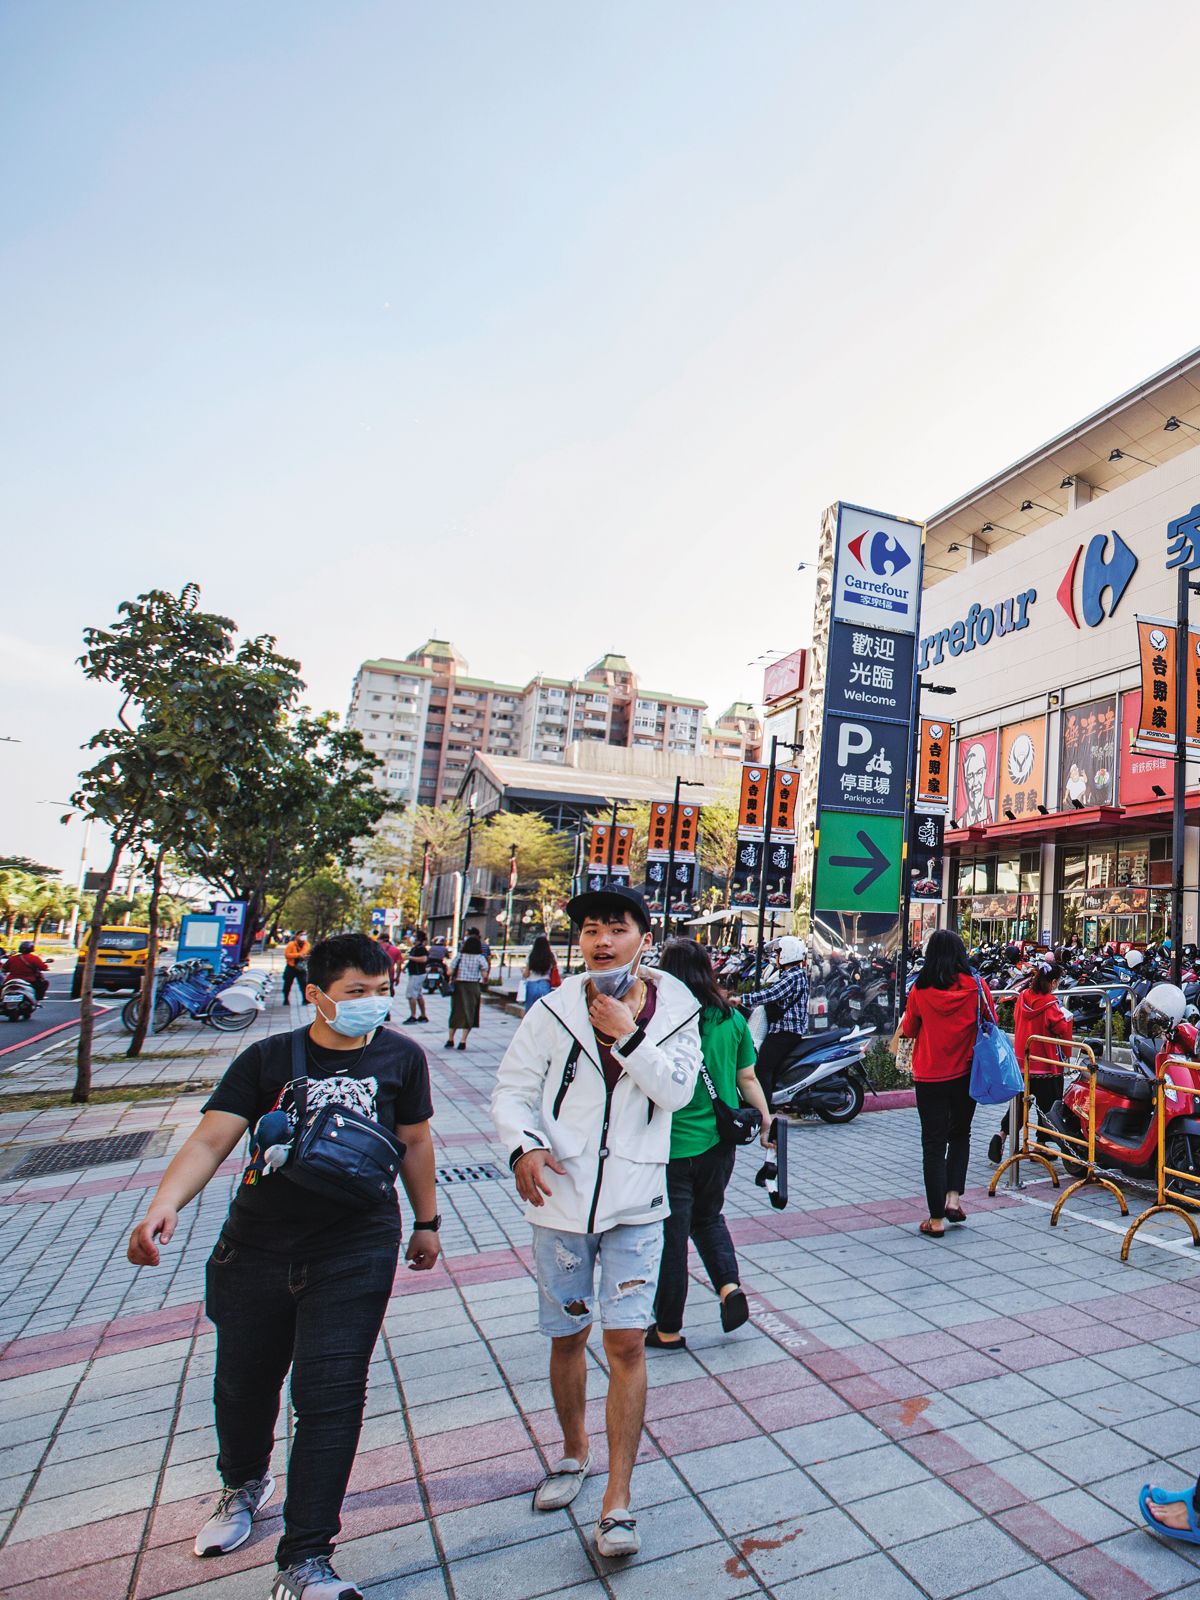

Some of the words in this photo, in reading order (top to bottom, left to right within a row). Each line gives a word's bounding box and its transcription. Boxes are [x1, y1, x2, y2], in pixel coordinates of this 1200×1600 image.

[844, 574, 909, 600] Carrefour
[860, 595, 893, 610] 家樂福
[918, 588, 1037, 673] rrefour
[851, 632, 895, 662] 歡迎
[849, 662, 894, 690] 光臨
[844, 688, 896, 707] Welcome
[1151, 655, 1168, 729] 吉野家
[837, 722, 873, 767] P
[840, 772, 890, 795] 停車場
[843, 793, 866, 805] Parking
[867, 795, 884, 805] Lot
[702, 1072, 718, 1100] adidas
